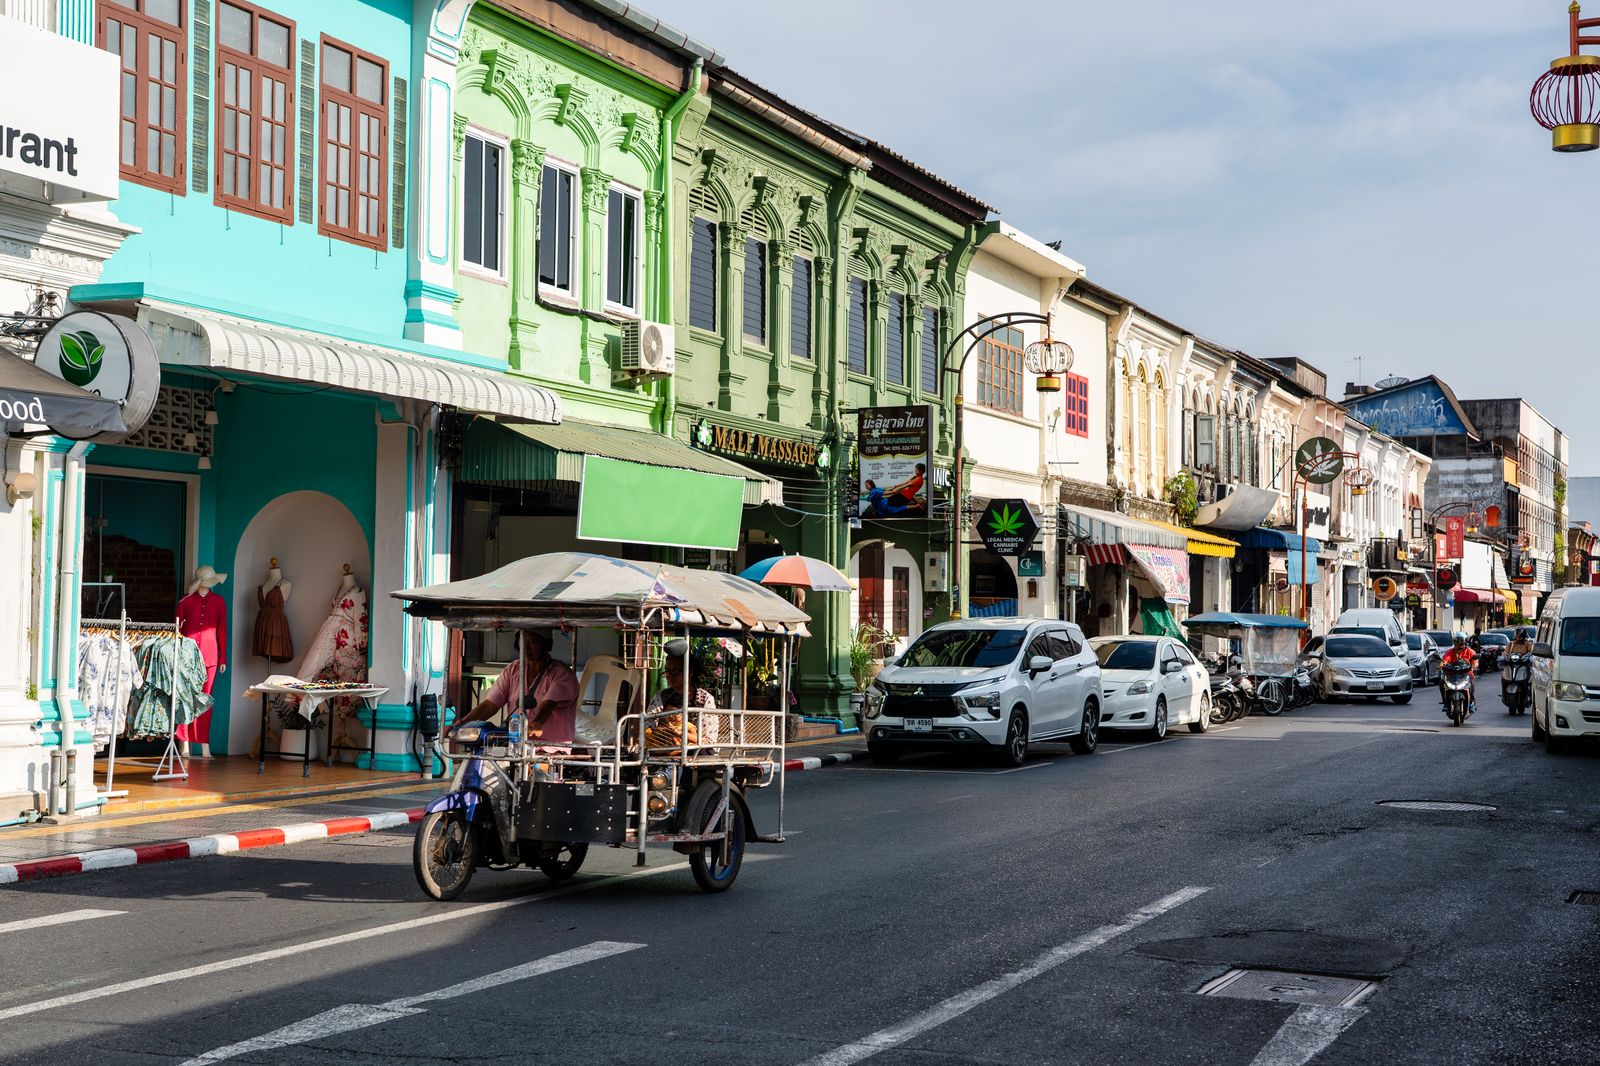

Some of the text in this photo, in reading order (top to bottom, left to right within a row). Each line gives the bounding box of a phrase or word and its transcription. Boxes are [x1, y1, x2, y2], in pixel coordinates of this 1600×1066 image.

[0, 125, 78, 177] rant
[715, 425, 816, 465] MALI MASSAGE
